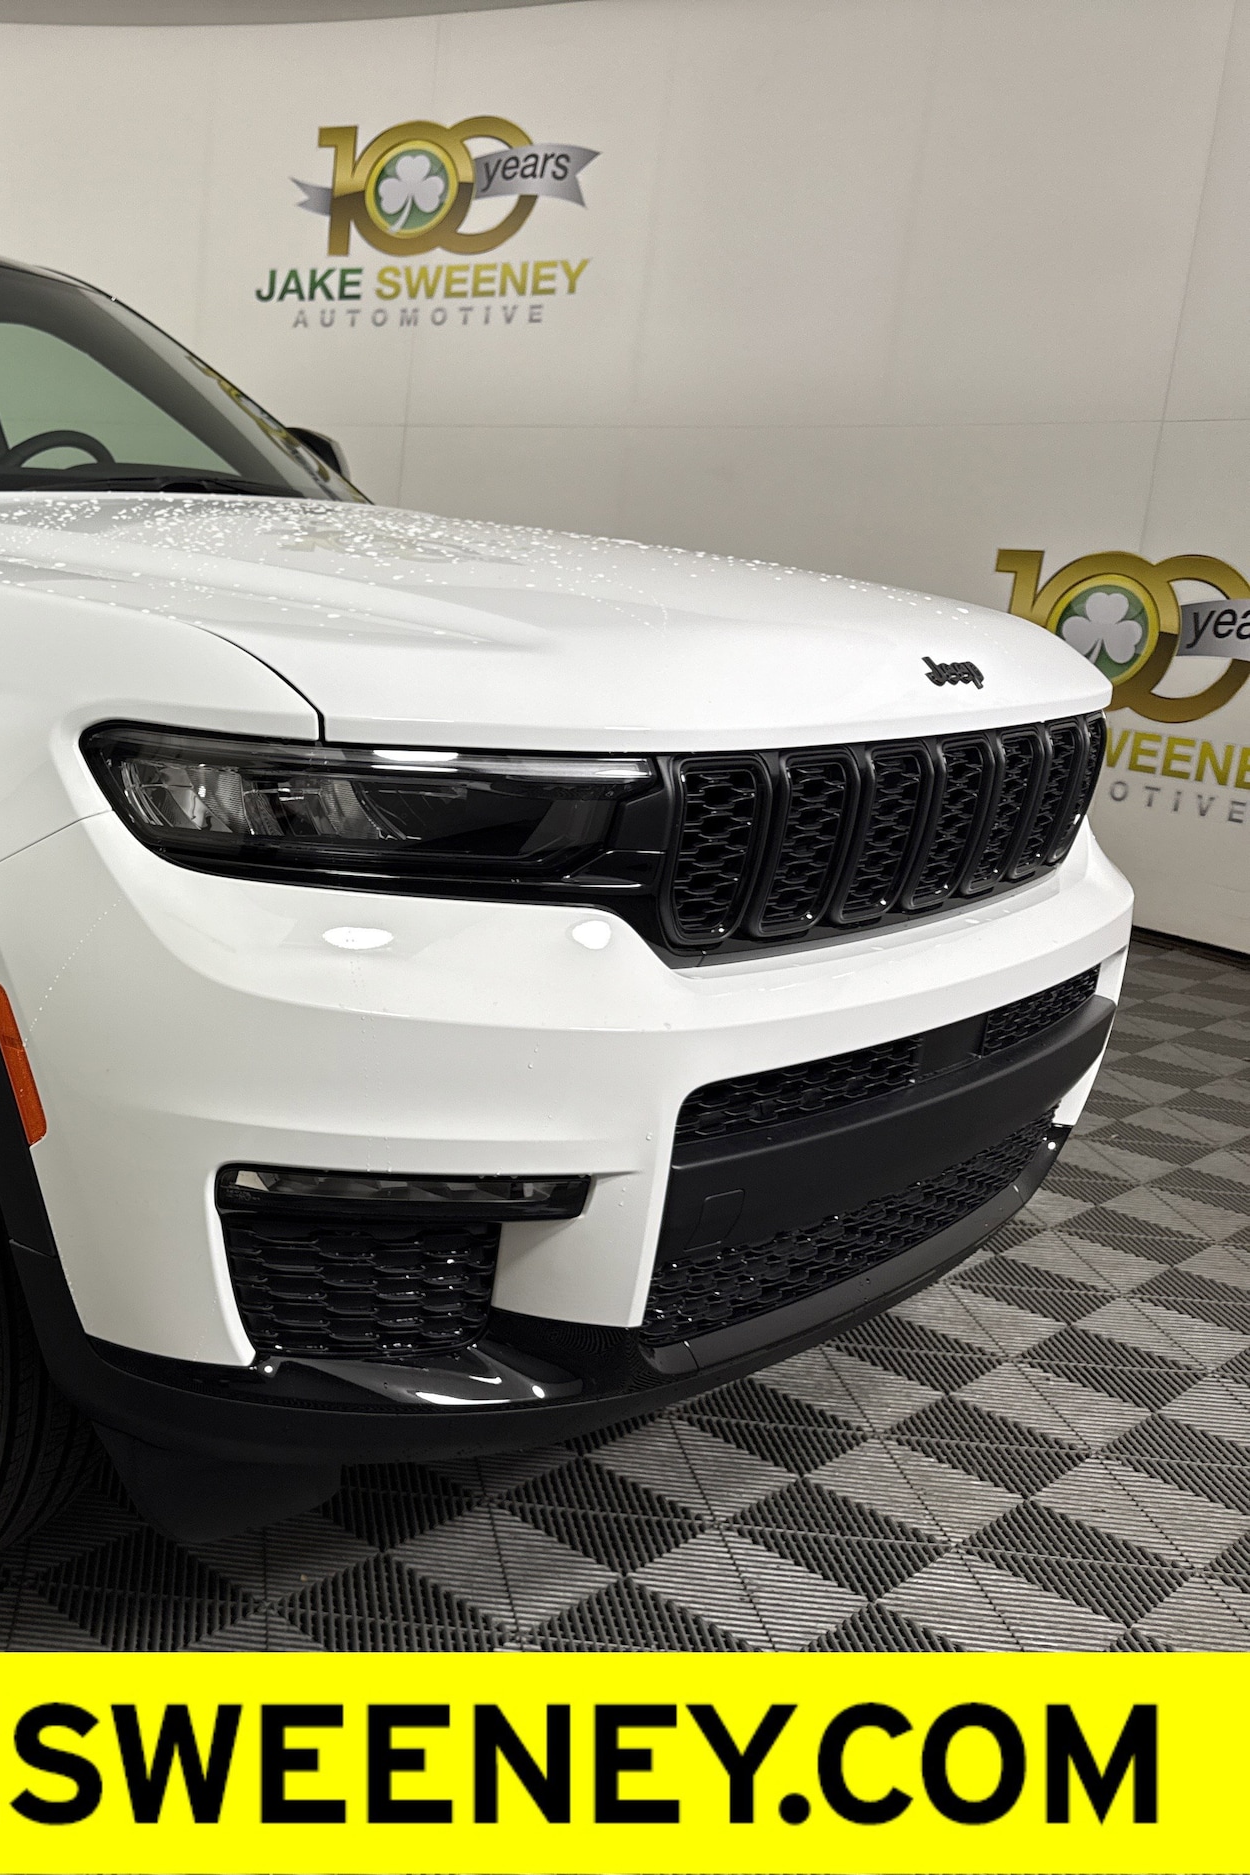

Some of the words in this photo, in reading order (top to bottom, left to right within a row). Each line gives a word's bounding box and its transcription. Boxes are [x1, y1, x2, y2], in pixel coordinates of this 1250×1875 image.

[318, 115, 539, 257] 100
[481, 151, 571, 192] years
[255, 268, 364, 302] JAKE
[375, 258, 589, 301] SWEENEY
[292, 304, 544, 328] AUTOMOTIVE
[921, 656, 984, 690] Jeep
